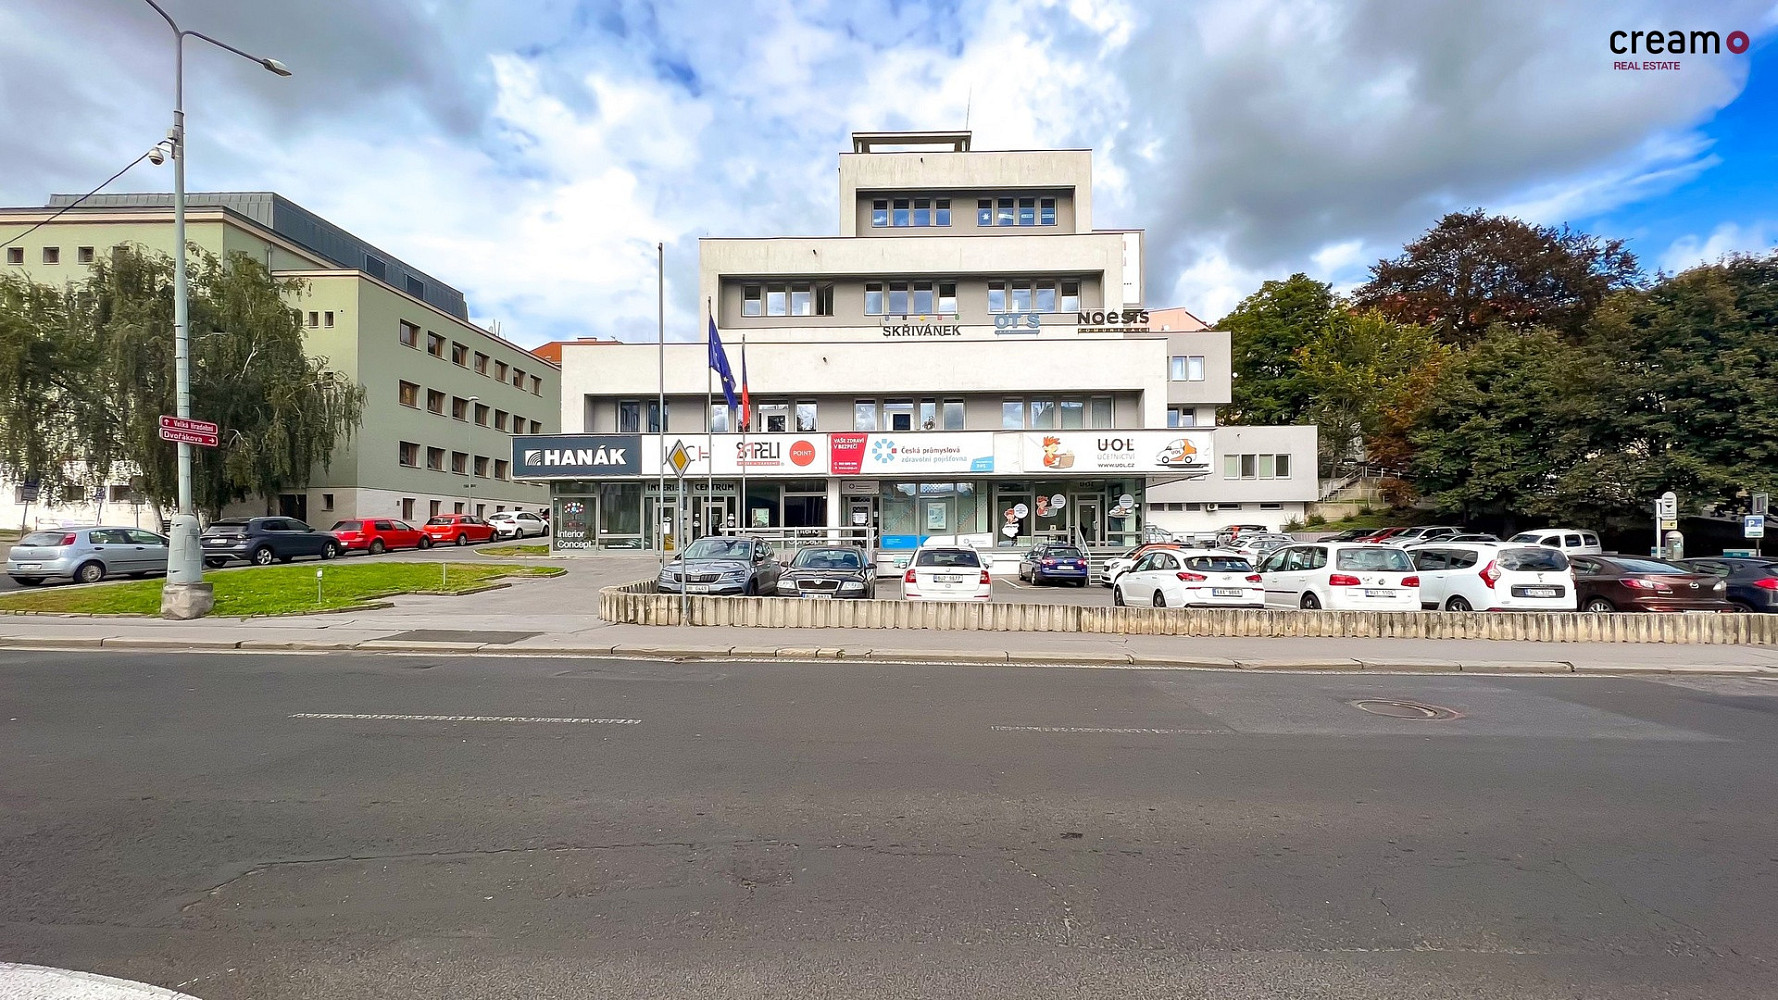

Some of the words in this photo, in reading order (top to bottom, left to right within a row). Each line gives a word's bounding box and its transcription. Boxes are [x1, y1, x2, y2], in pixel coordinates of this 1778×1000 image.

[883, 323, 961, 337] SKŘIVÁNEK
[163, 430, 203, 443] Dvořákova
[544, 444, 627, 466] HANÁK
[901, 445, 921, 454] Česká
[922, 446, 961, 456] průmyslová
[694, 483, 734, 491] CENTRUM
[557, 530, 585, 538] Interior
[557, 540, 592, 549] Concept
